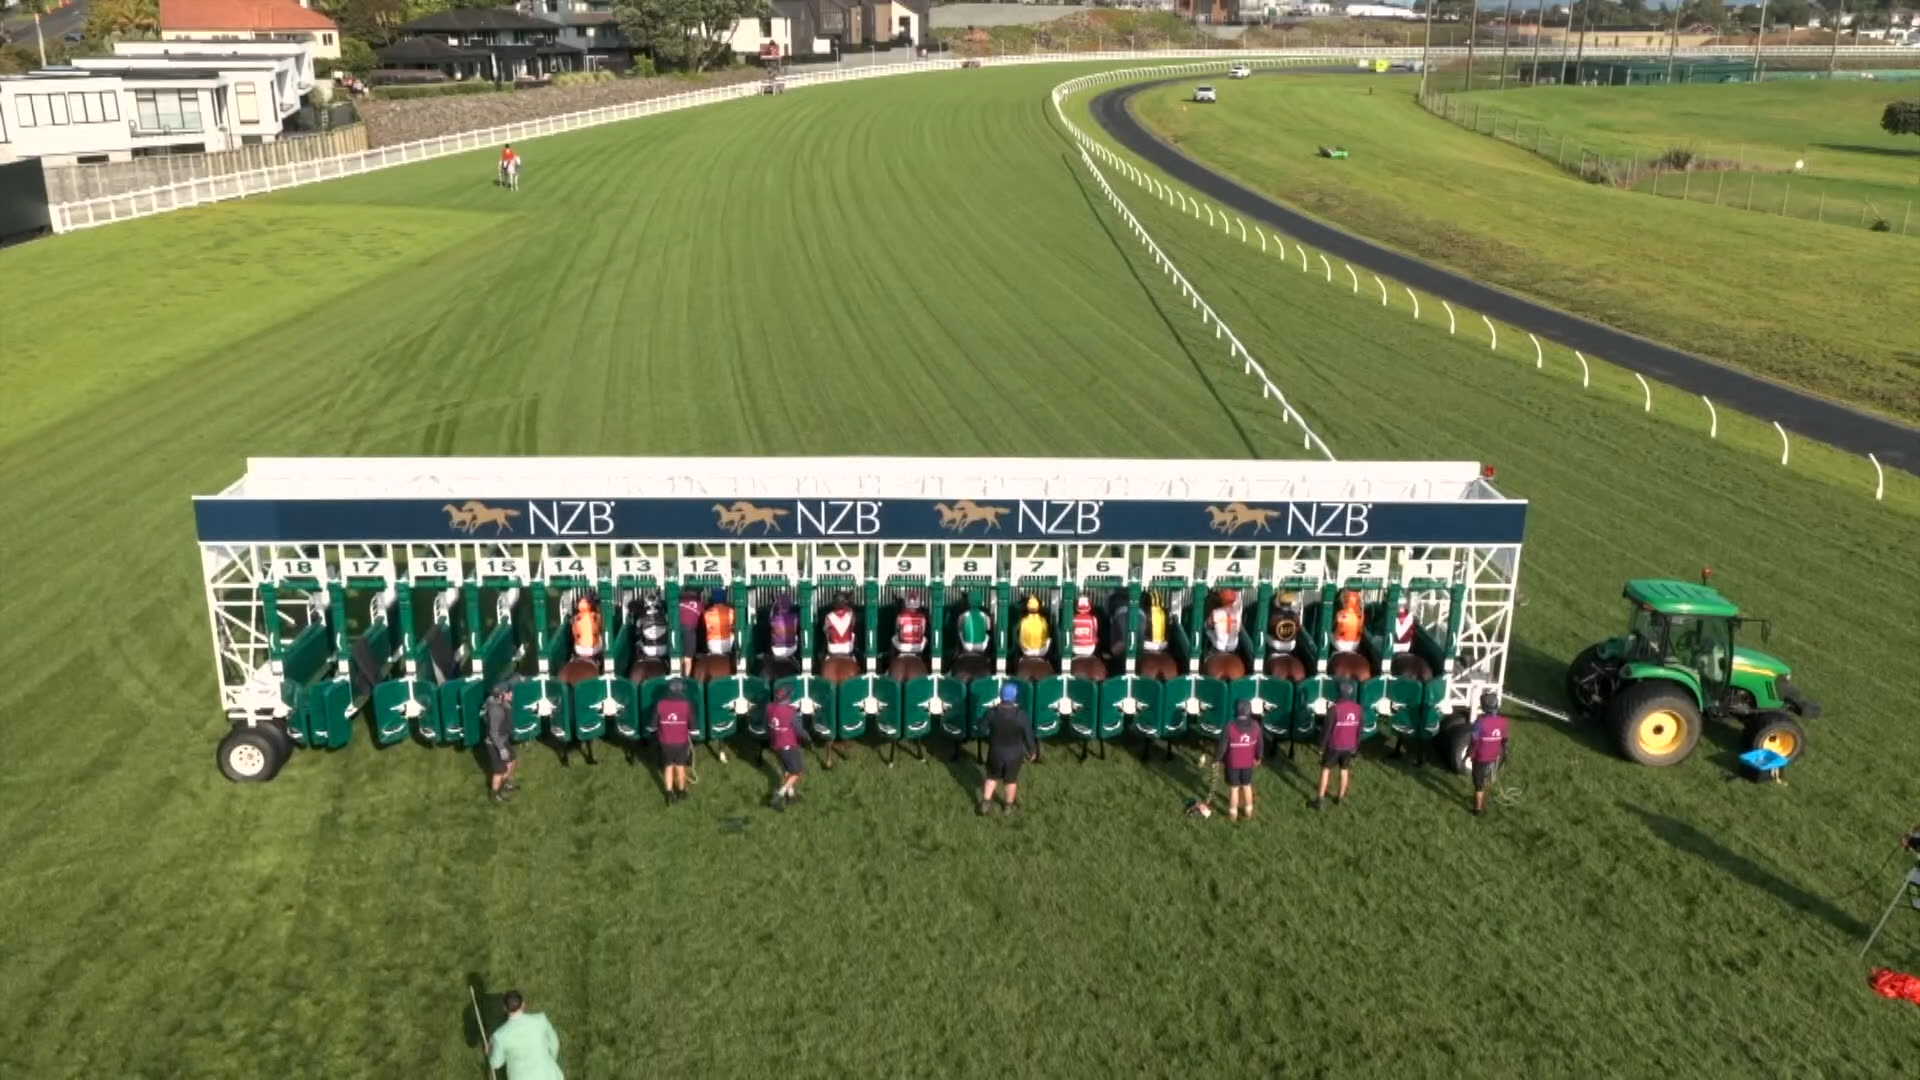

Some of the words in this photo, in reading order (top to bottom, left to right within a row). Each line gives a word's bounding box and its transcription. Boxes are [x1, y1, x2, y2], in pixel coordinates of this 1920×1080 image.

[528, 501, 616, 536] NZB
[796, 501, 882, 536] NZB
[1017, 501, 1104, 536] NZB
[1286, 501, 1371, 537] NZB
[285, 561, 312, 574] 18
[352, 561, 380, 573] 17
[421, 560, 448, 573] 16
[488, 560, 516, 573] 15
[555, 560, 584, 572] 14
[624, 560, 651, 572] 13
[690, 560, 718, 572] 12
[760, 560, 783, 572] 11
[825, 559, 852, 571] 10
[899, 560, 912, 572] 9
[963, 561, 978, 572] 8
[1031, 560, 1045, 572] 7
[1096, 561, 1110, 572] 6
[1162, 561, 1176, 573] 5
[1226, 561, 1241, 573] 4
[1293, 562, 1306, 574] 3
[1358, 562, 1372, 574] 2
[1426, 563, 1433, 574] 1
